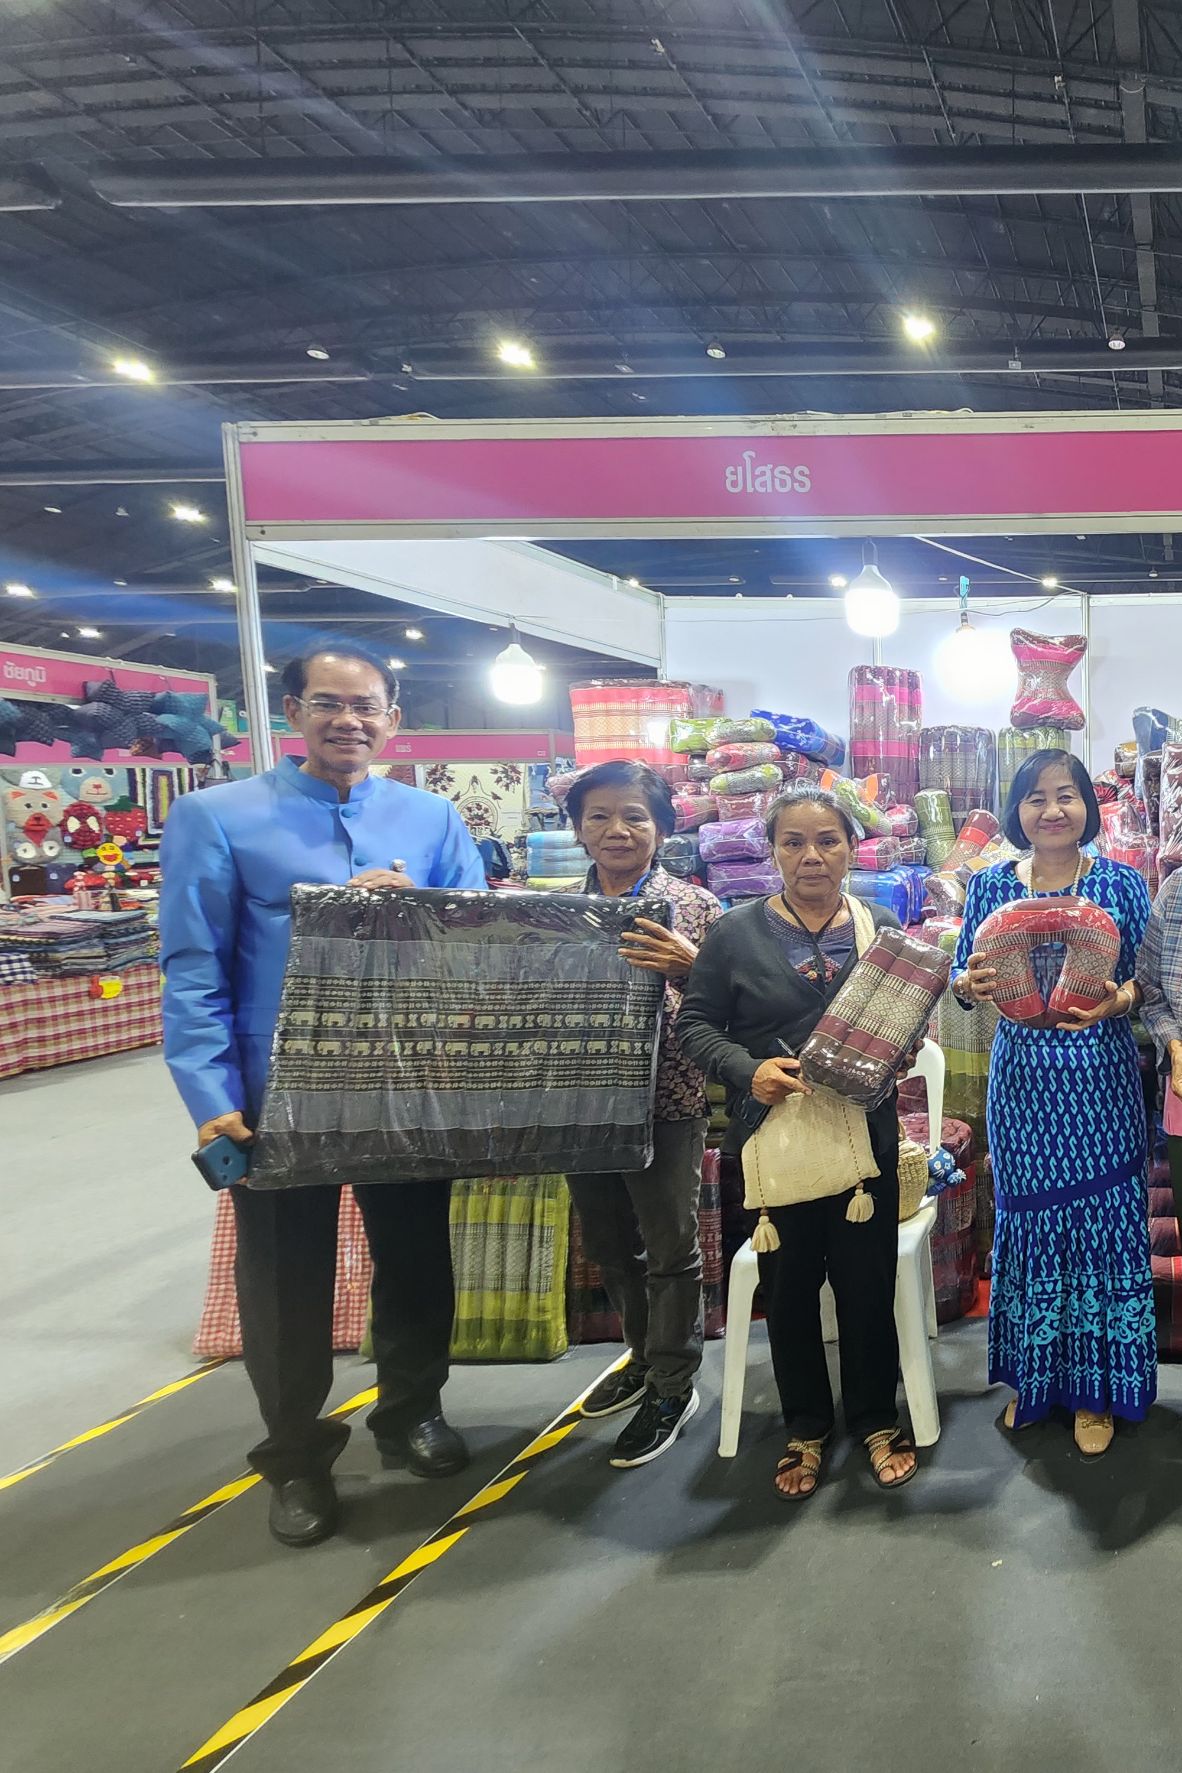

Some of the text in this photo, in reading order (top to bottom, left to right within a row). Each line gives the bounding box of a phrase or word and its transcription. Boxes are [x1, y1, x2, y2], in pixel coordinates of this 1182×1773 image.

[725, 450, 811, 493] ยโสธร
[3, 660, 47, 687] ชัยภูมิ
